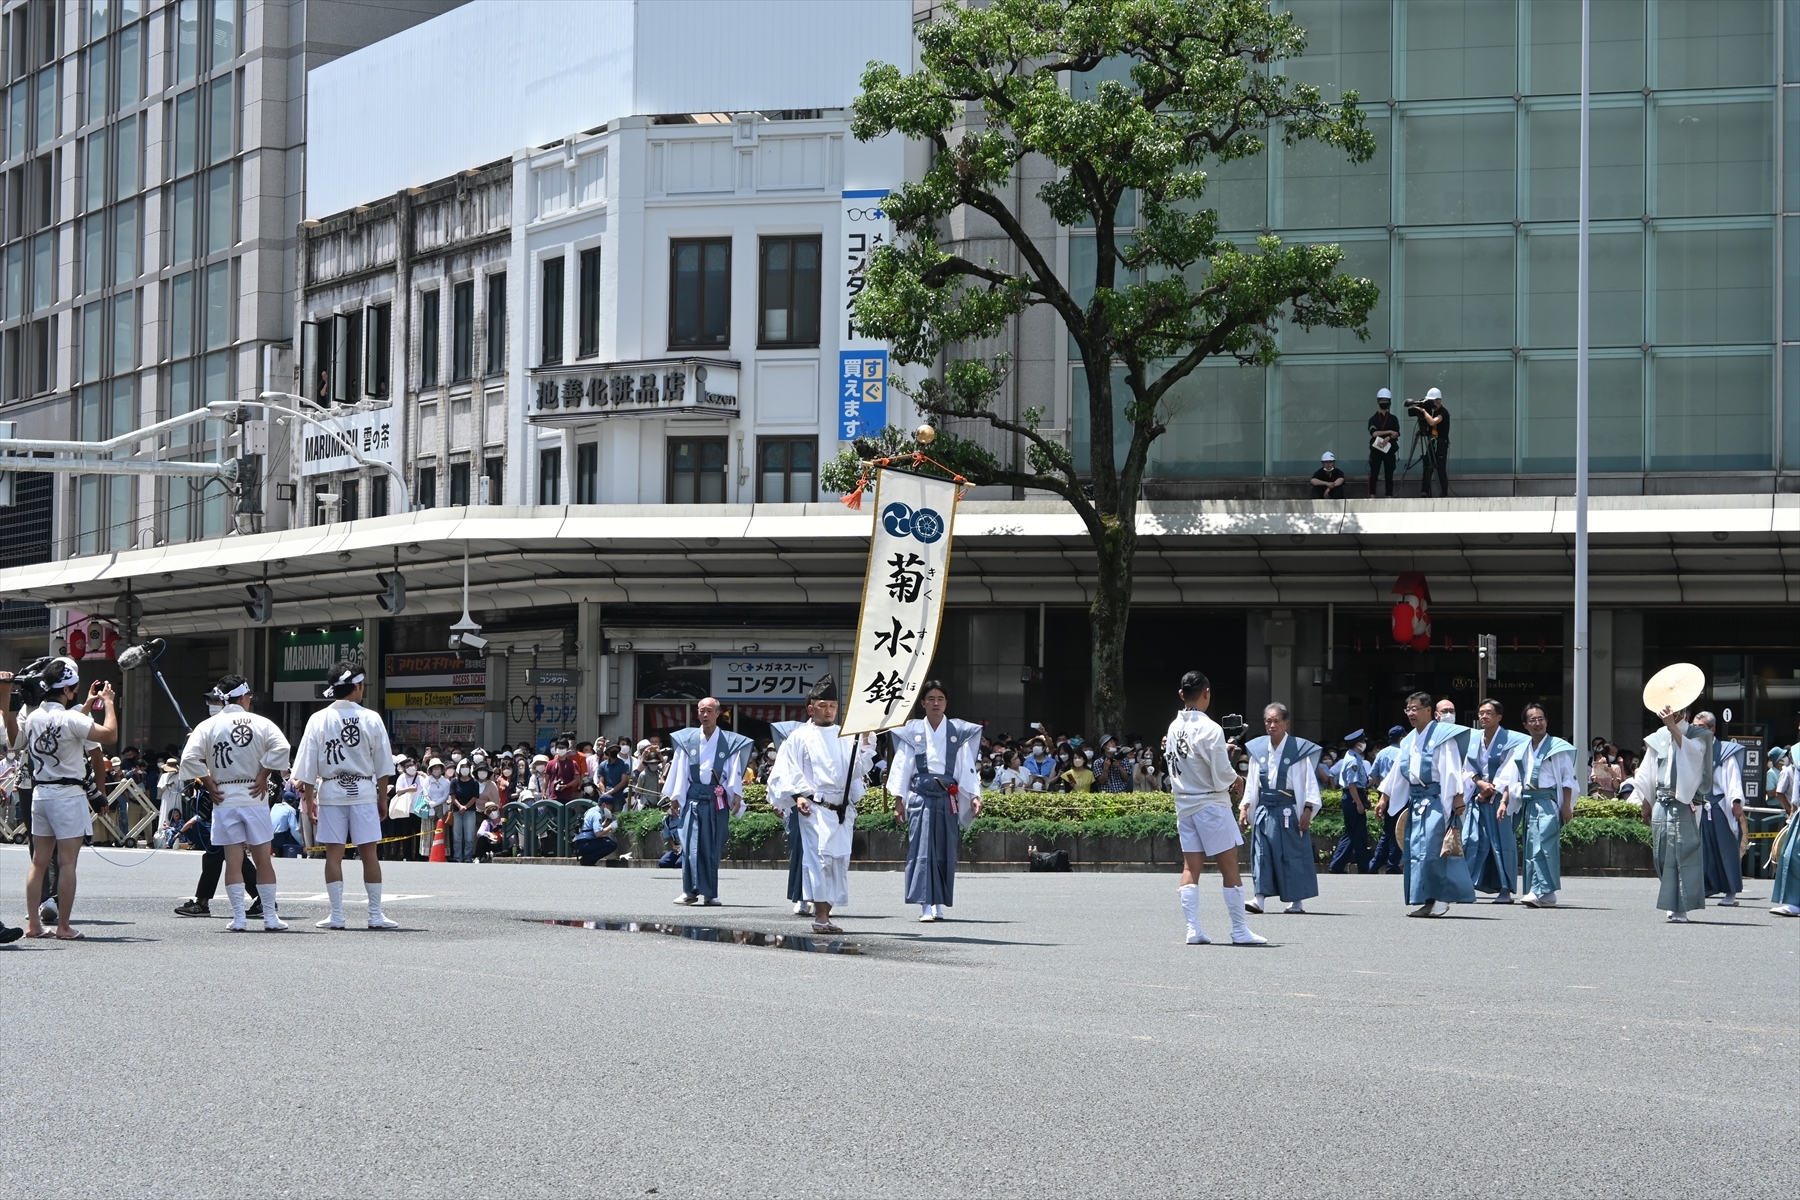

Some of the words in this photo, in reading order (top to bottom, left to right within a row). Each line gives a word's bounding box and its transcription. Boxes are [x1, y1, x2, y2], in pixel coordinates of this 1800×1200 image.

[864, 359, 882, 401] すぐ
[536, 371, 686, 410] 池善化粧品店
[843, 358, 861, 438] 買えます
[363, 422, 390, 452] 雲の茶
[862, 552, 926, 715] 菊水鉾
[284, 643, 335, 671] MARUMARU
[398, 656, 465, 671] アクセスチケット
[755, 662, 815, 672] メガネスーパー
[452, 674, 470, 685] ACCESS
[727, 676, 814, 694] コンタクト
[1467, 678, 1534, 691] Taashimaya
[405, 693, 423, 707] Money
[424, 693, 452, 706] EXchange
[453, 695, 460, 703] No
